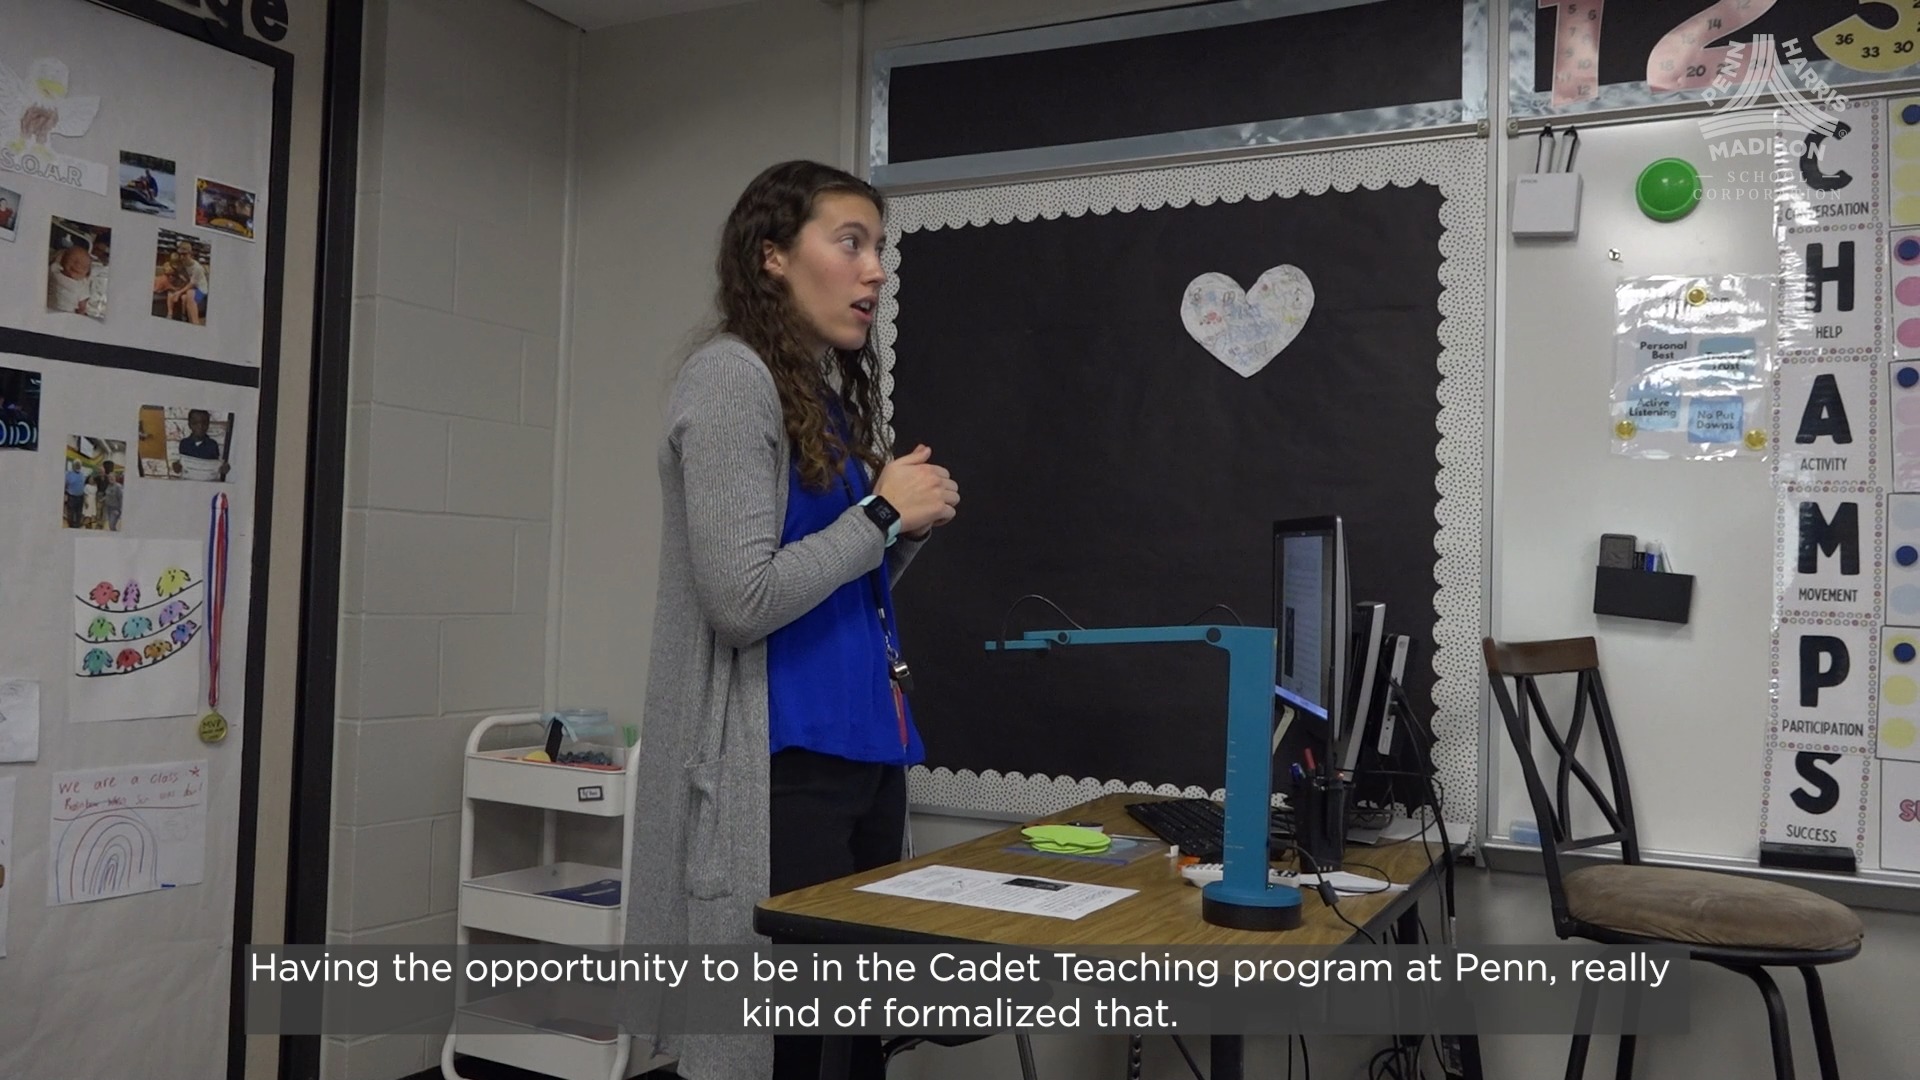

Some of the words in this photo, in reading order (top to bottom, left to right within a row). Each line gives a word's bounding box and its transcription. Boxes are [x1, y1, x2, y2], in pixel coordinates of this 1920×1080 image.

[1568, 4, 1577, 14] 5
[1587, 9, 1597, 20] 6
[1707, 18, 1722, 30] 14
[1835, 33, 1854, 45] 36
[1861, 46, 1880, 58] 33
[1893, 40, 1914, 53] 30
[1686, 65, 1706, 77] 20
[1577, 85, 1591, 96] 12
[1785, 201, 1869, 221] CERSATION
[1805, 240, 1855, 313] H
[1815, 325, 1843, 339] HELP
[1640, 341, 1688, 351] Personal
[1652, 351, 1674, 360] Best
[1637, 398, 1670, 408] Active
[1795, 373, 1853, 444] A
[1629, 407, 1677, 419] Listening
[1697, 411, 1712, 420] No
[1715, 410, 1735, 420] Put
[1696, 420, 1734, 431] Downs
[1800, 458, 1848, 472] ACTIVITY
[1797, 501, 1860, 576] M
[1798, 588, 1858, 603] MOVEMENT
[1800, 635, 1850, 708] P
[1782, 719, 1864, 737] PARTICIPATION
[93, 776, 117, 790] are
[131, 775, 139, 785] a
[1790, 751, 1842, 815] S
[1786, 824, 1838, 843] SUCCESS
